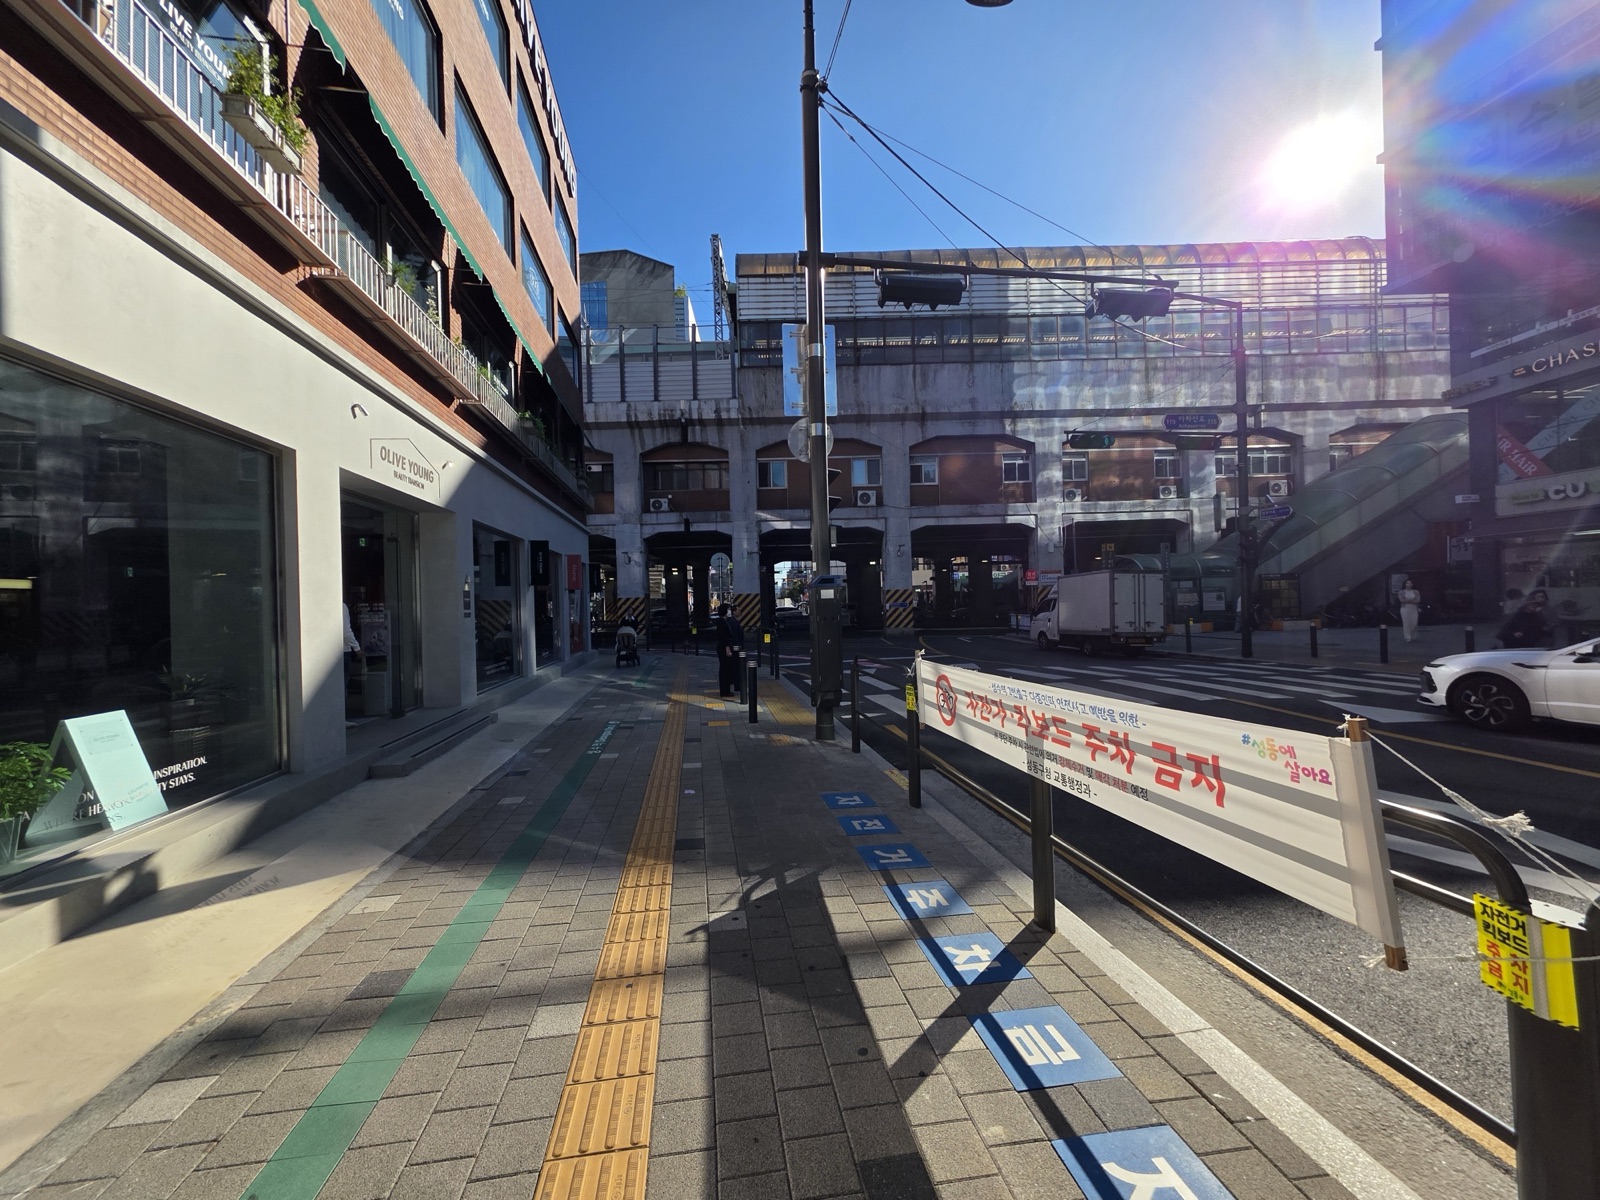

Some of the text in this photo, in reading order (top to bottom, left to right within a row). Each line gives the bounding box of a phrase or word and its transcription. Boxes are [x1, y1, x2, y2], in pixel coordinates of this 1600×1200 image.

[159, 0, 232, 79] LIVE YOUN
[1531, 341, 1600, 373] CHAS
[1178, 415, 1205, 423] 아차산로
[380, 445, 434, 483] OLIVE YOUNG
[1547, 481, 1585, 500] CU
[1119, 711, 1141, 729] 위한
[1026, 758, 1092, 798] 성동구청 교통행정과
[1081, 722, 1138, 775] 주차
[1151, 744, 1227, 808] 금지
[1284, 760, 1333, 785] 살아요
[1130, 784, 1149, 802] 예정
[1479, 901, 1527, 937] 자전거
[1482, 919, 1530, 956] 킥보드
